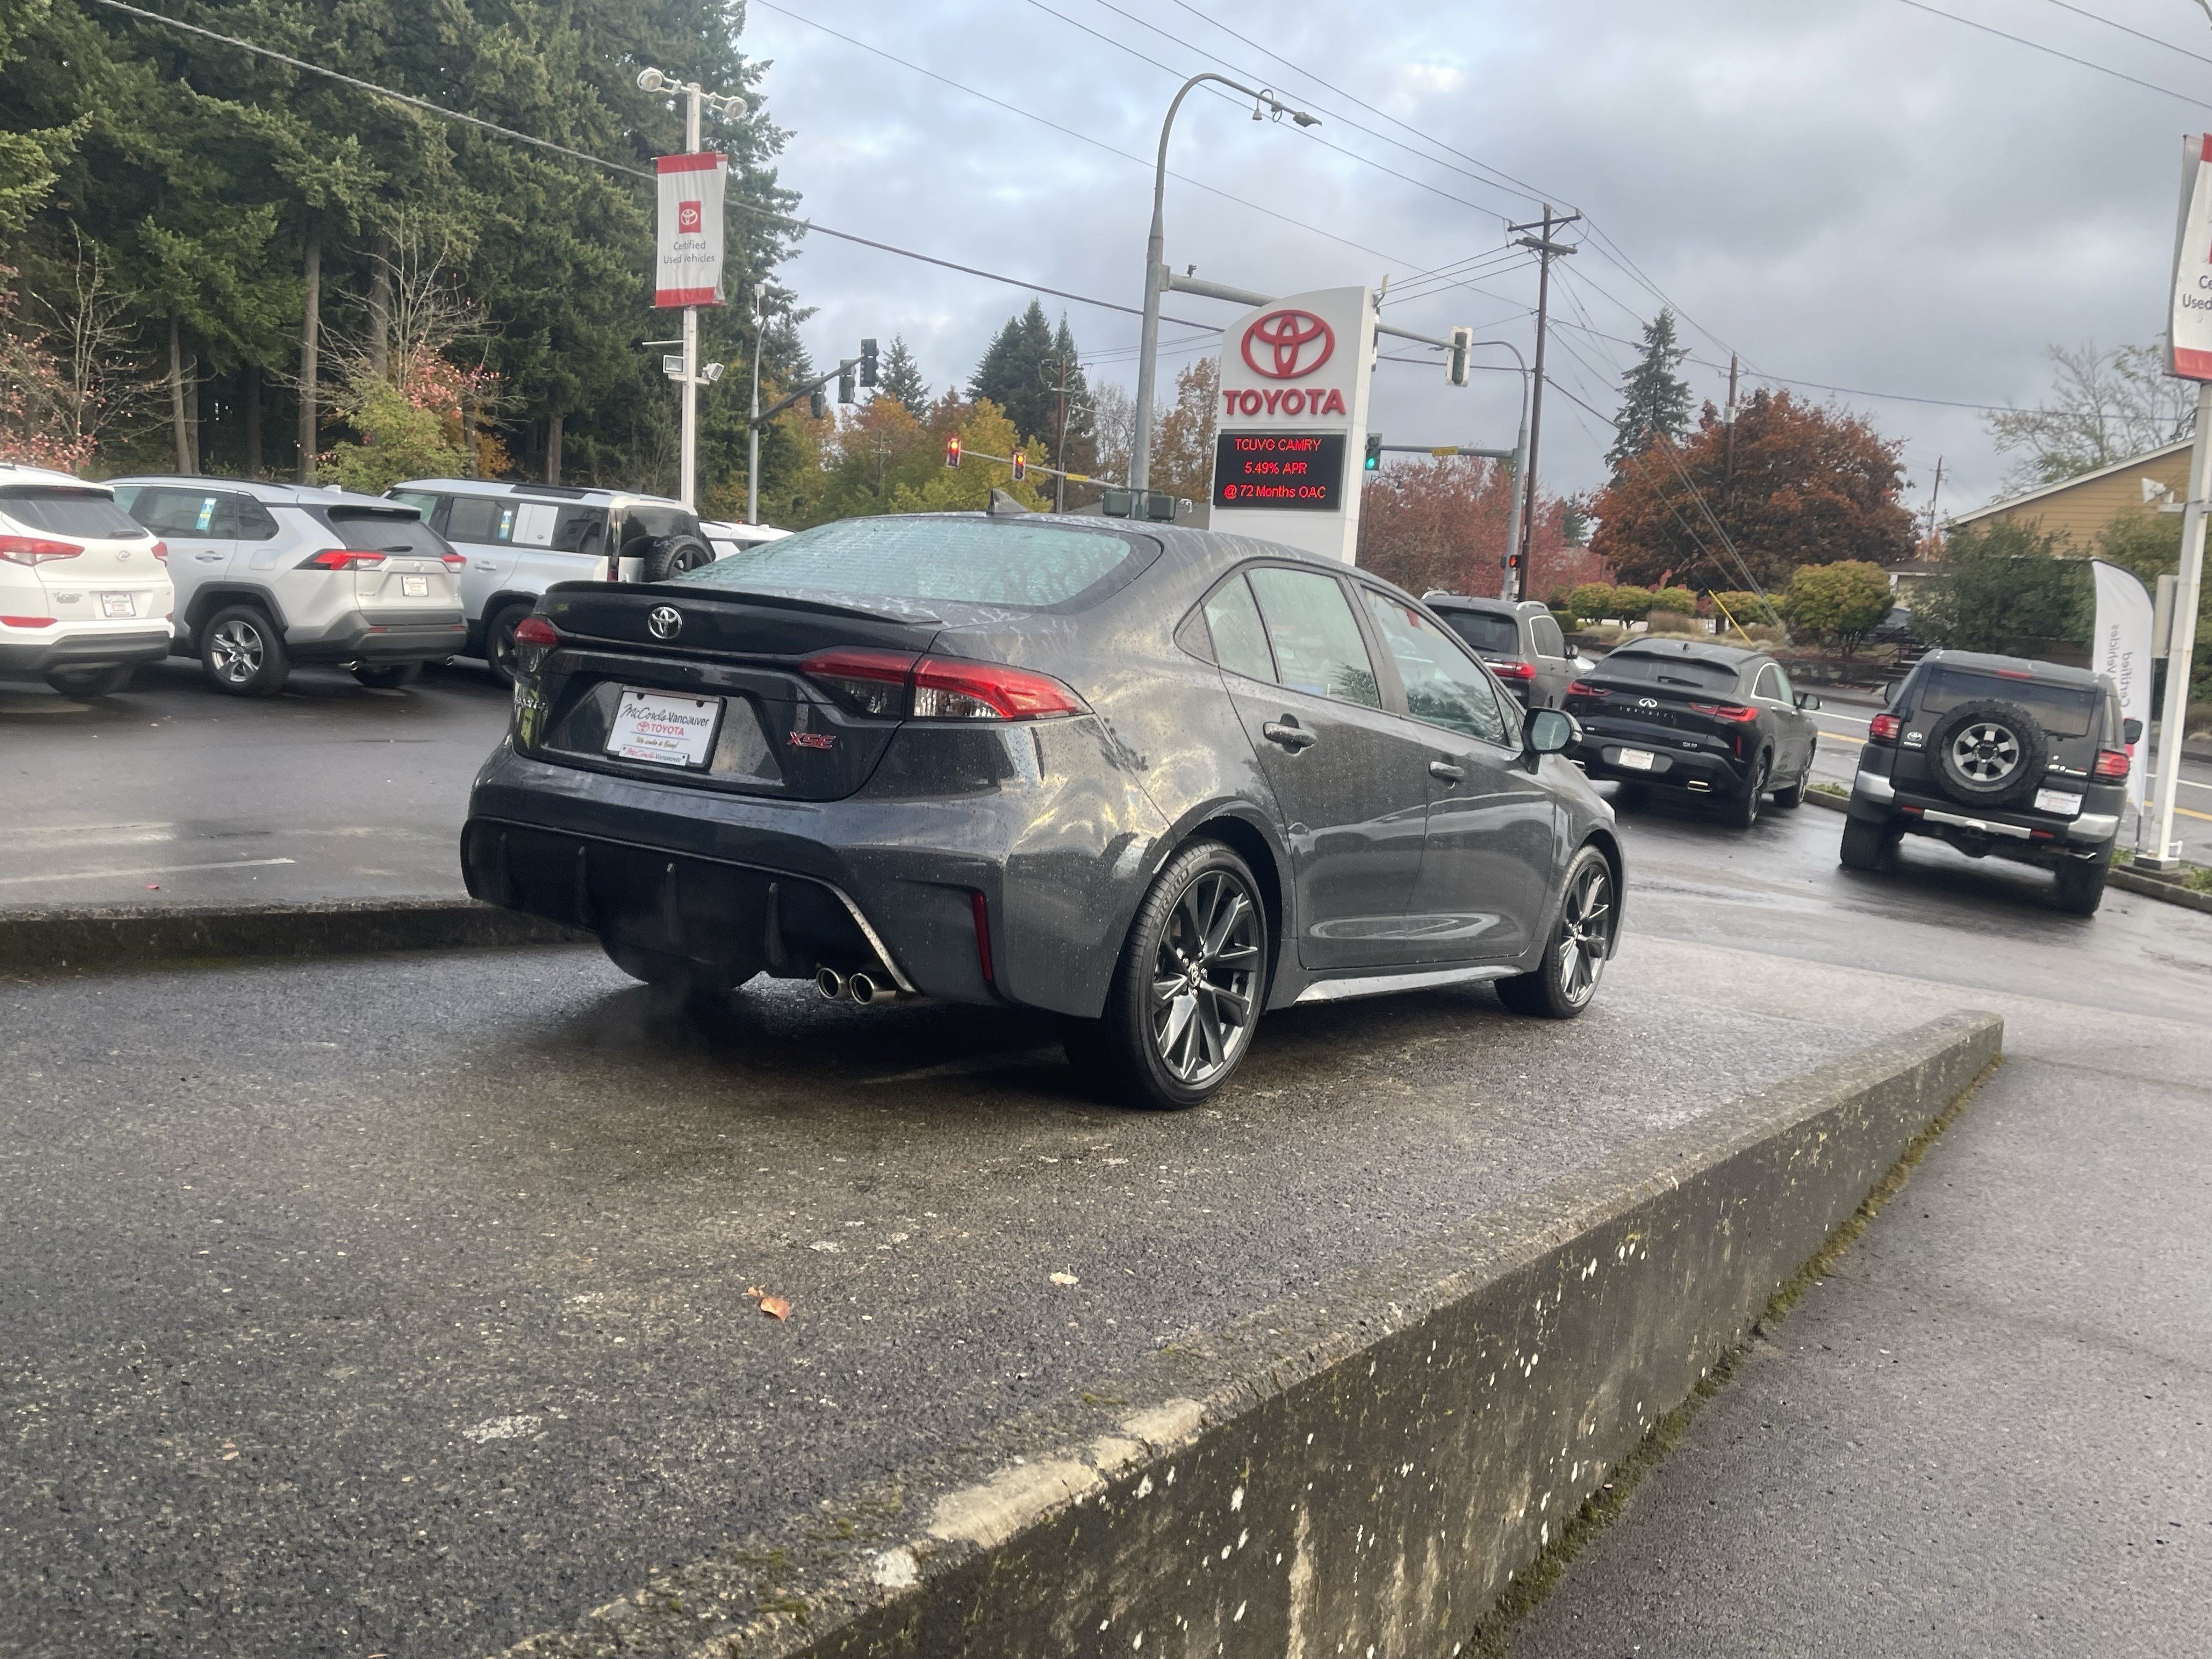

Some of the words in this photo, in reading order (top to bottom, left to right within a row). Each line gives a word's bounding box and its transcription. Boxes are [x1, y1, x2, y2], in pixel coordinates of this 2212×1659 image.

[674, 240, 706, 250] Certified
[663, 254, 682, 263] Used
[1222, 388, 1346, 415] TOYOTA
[1277, 438, 1322, 452] CAMRY
[1244, 461, 1280, 475] 5.49%
[1282, 461, 1307, 475] APR
[1223, 483, 1237, 499] @
[1240, 484, 1254, 497] 72
[1256, 484, 1296, 498] Months
[1299, 486, 1326, 499] OAC
[669, 712, 710, 727] Vancouver
[651, 724, 684, 736] TOYOTA
[786, 731, 836, 750] XSE
